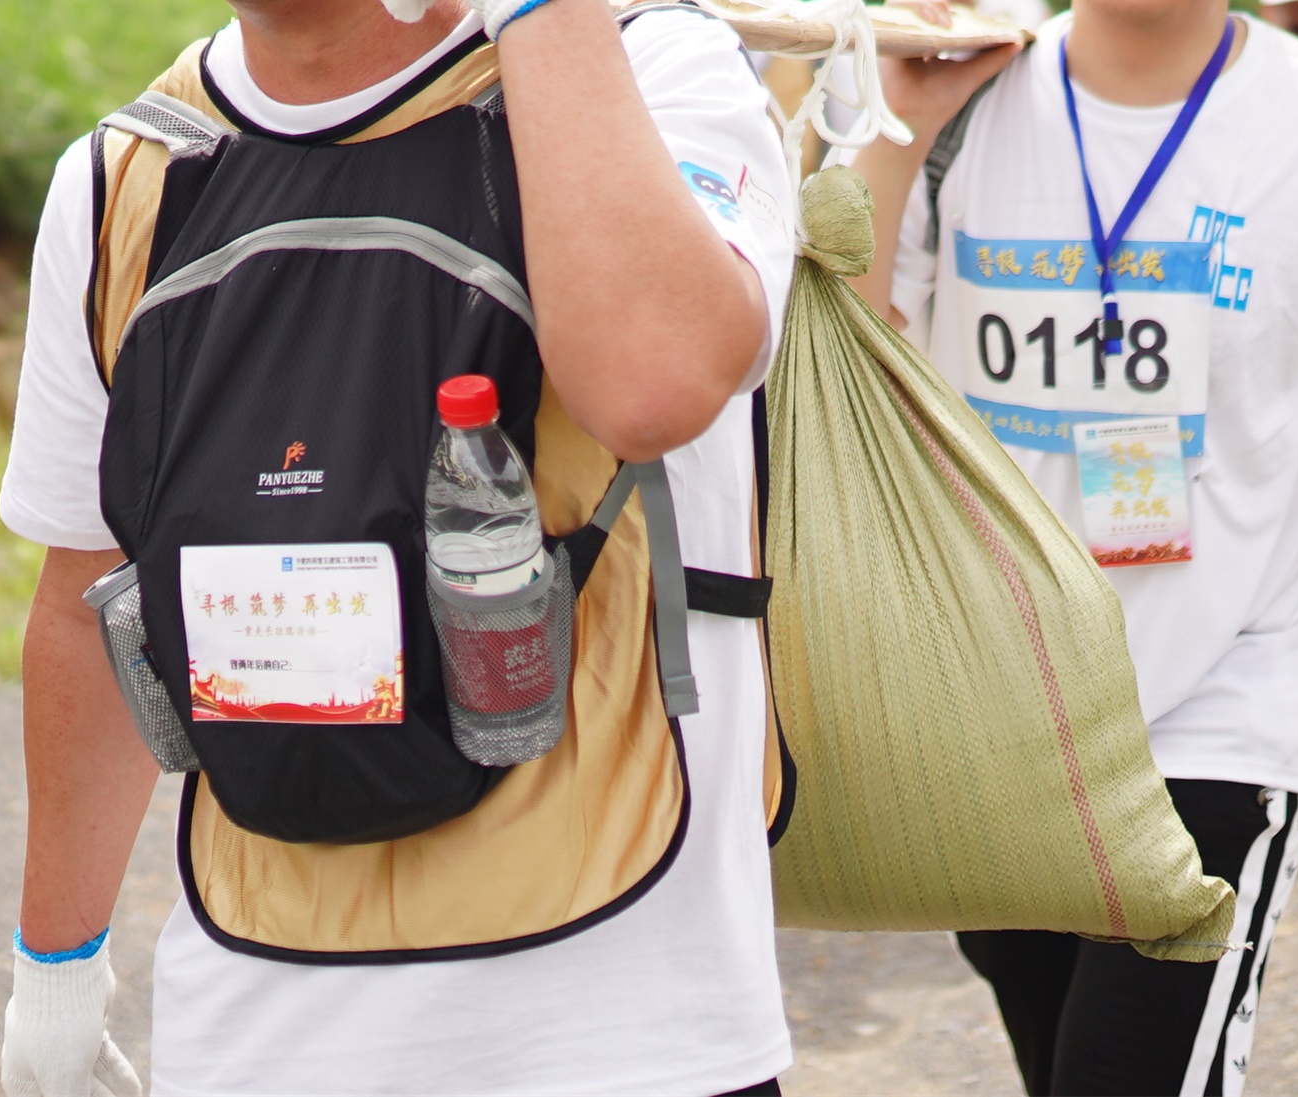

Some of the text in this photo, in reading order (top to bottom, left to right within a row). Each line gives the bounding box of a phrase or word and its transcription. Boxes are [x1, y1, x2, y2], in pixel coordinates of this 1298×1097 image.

[976, 246, 1023, 279] 寻根
[1030, 244, 1086, 286] 筑梦
[977, 313, 1170, 395] 0118
[258, 470, 324, 486] PANYUEZHE
[200, 591, 372, 618] 寻根 筑梦 再出发
